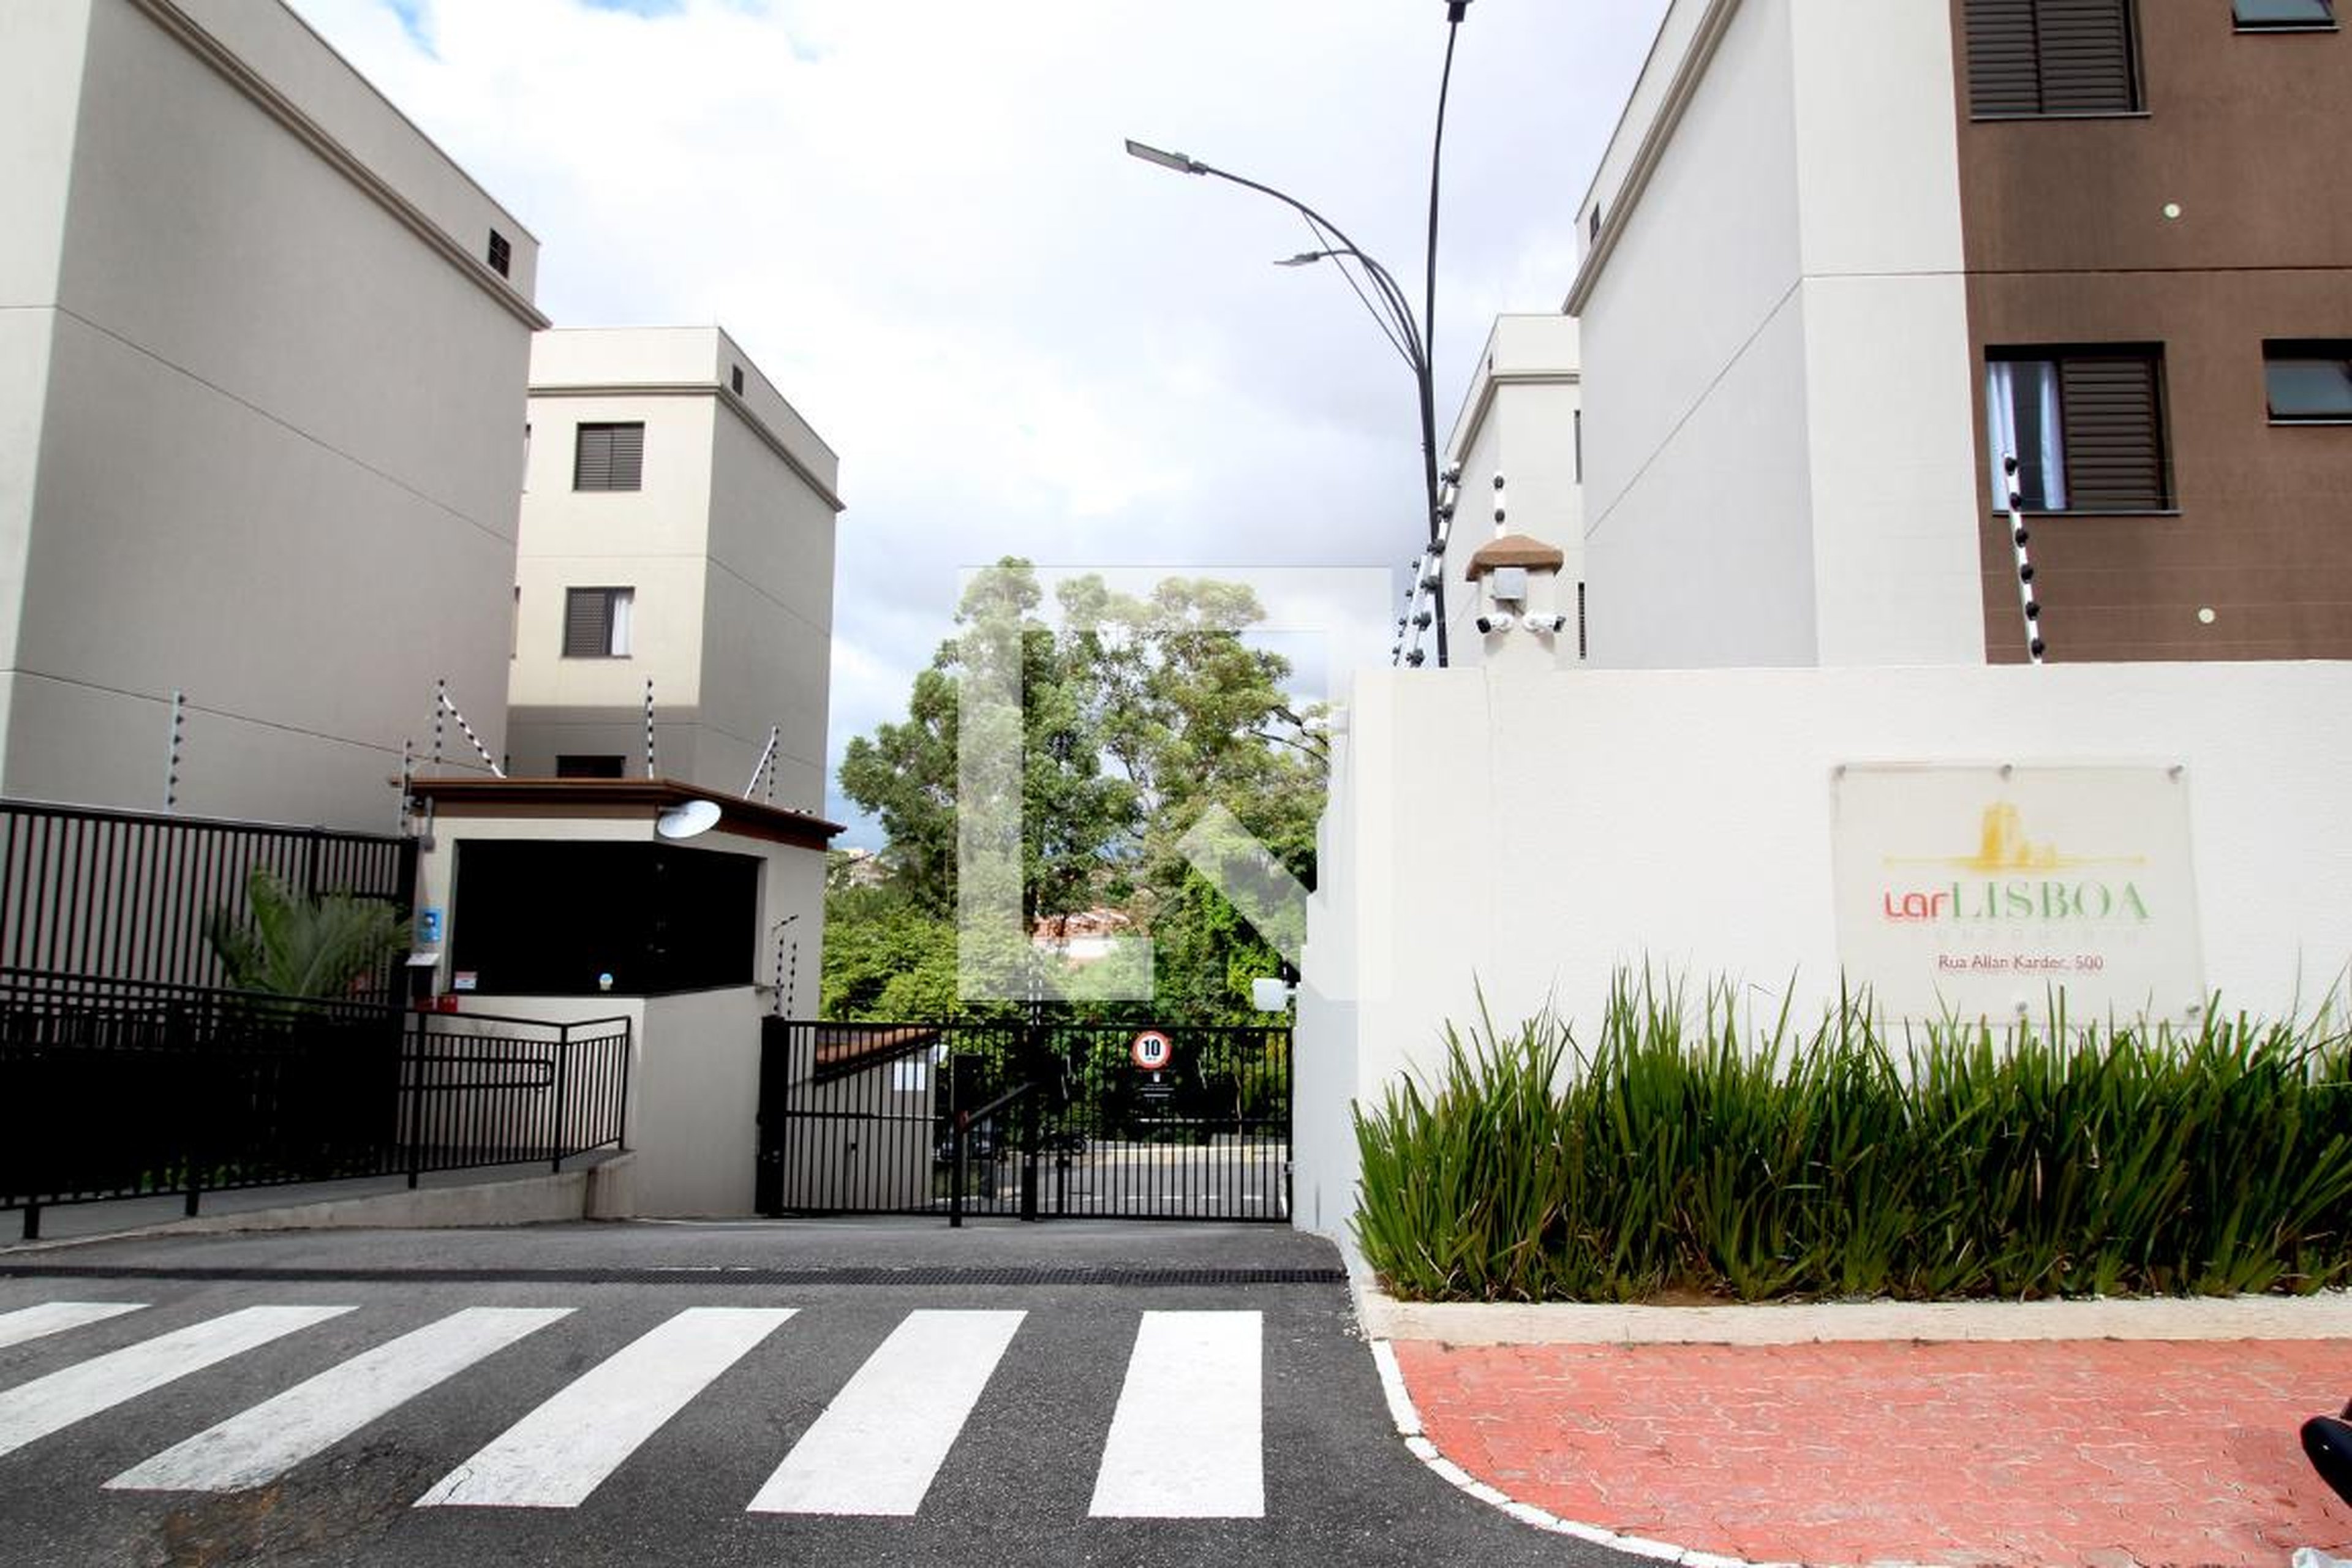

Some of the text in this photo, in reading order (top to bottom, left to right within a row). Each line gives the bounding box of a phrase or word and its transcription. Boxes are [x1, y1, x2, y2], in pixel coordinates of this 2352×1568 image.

[1938, 954, 1967, 970] Rua
[1971, 954, 2009, 970] Allan
[2075, 954, 2105, 970] 500
[1143, 1039, 1161, 1057] 10
